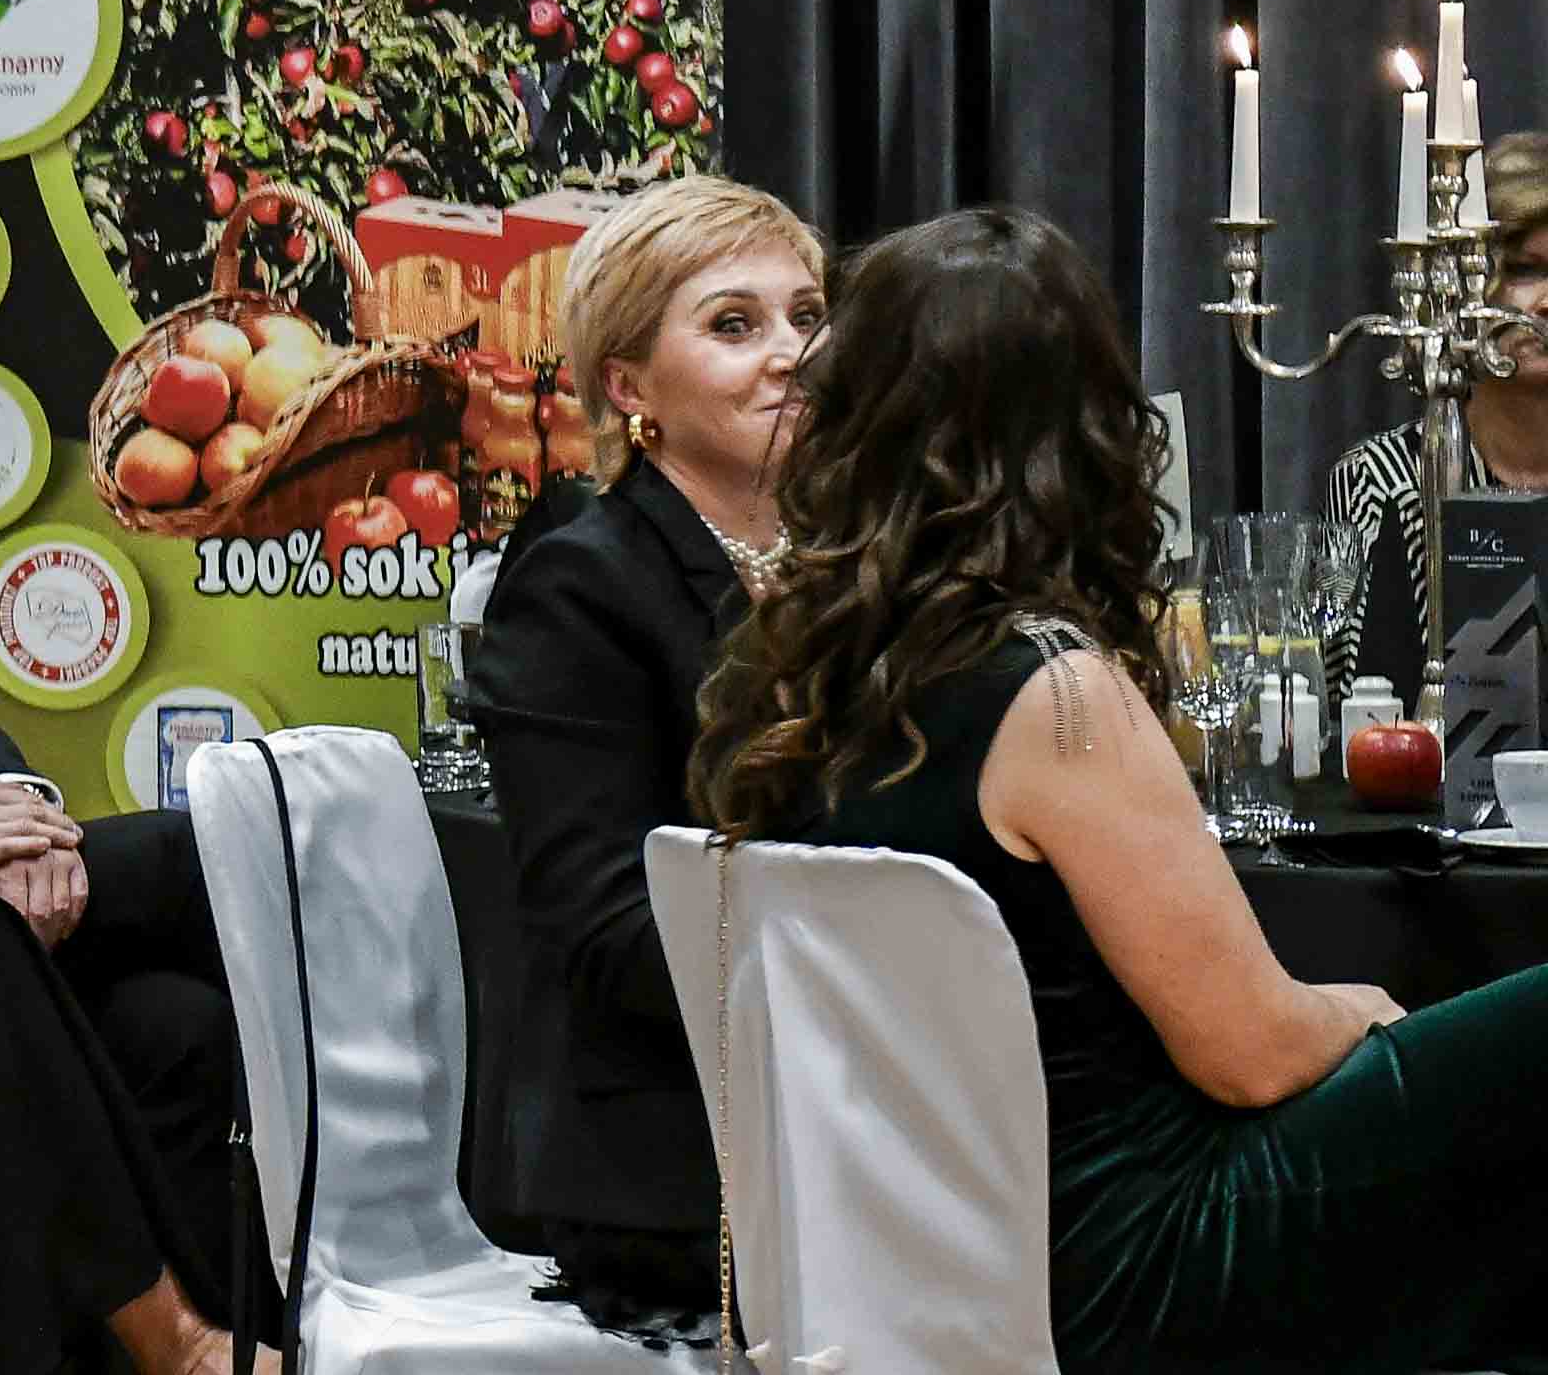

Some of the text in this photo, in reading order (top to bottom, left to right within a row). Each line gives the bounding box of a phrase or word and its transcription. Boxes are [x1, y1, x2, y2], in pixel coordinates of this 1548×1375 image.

[196, 528, 333, 596] 100%
[342, 531, 442, 598] sok
[320, 630, 418, 675] natu
